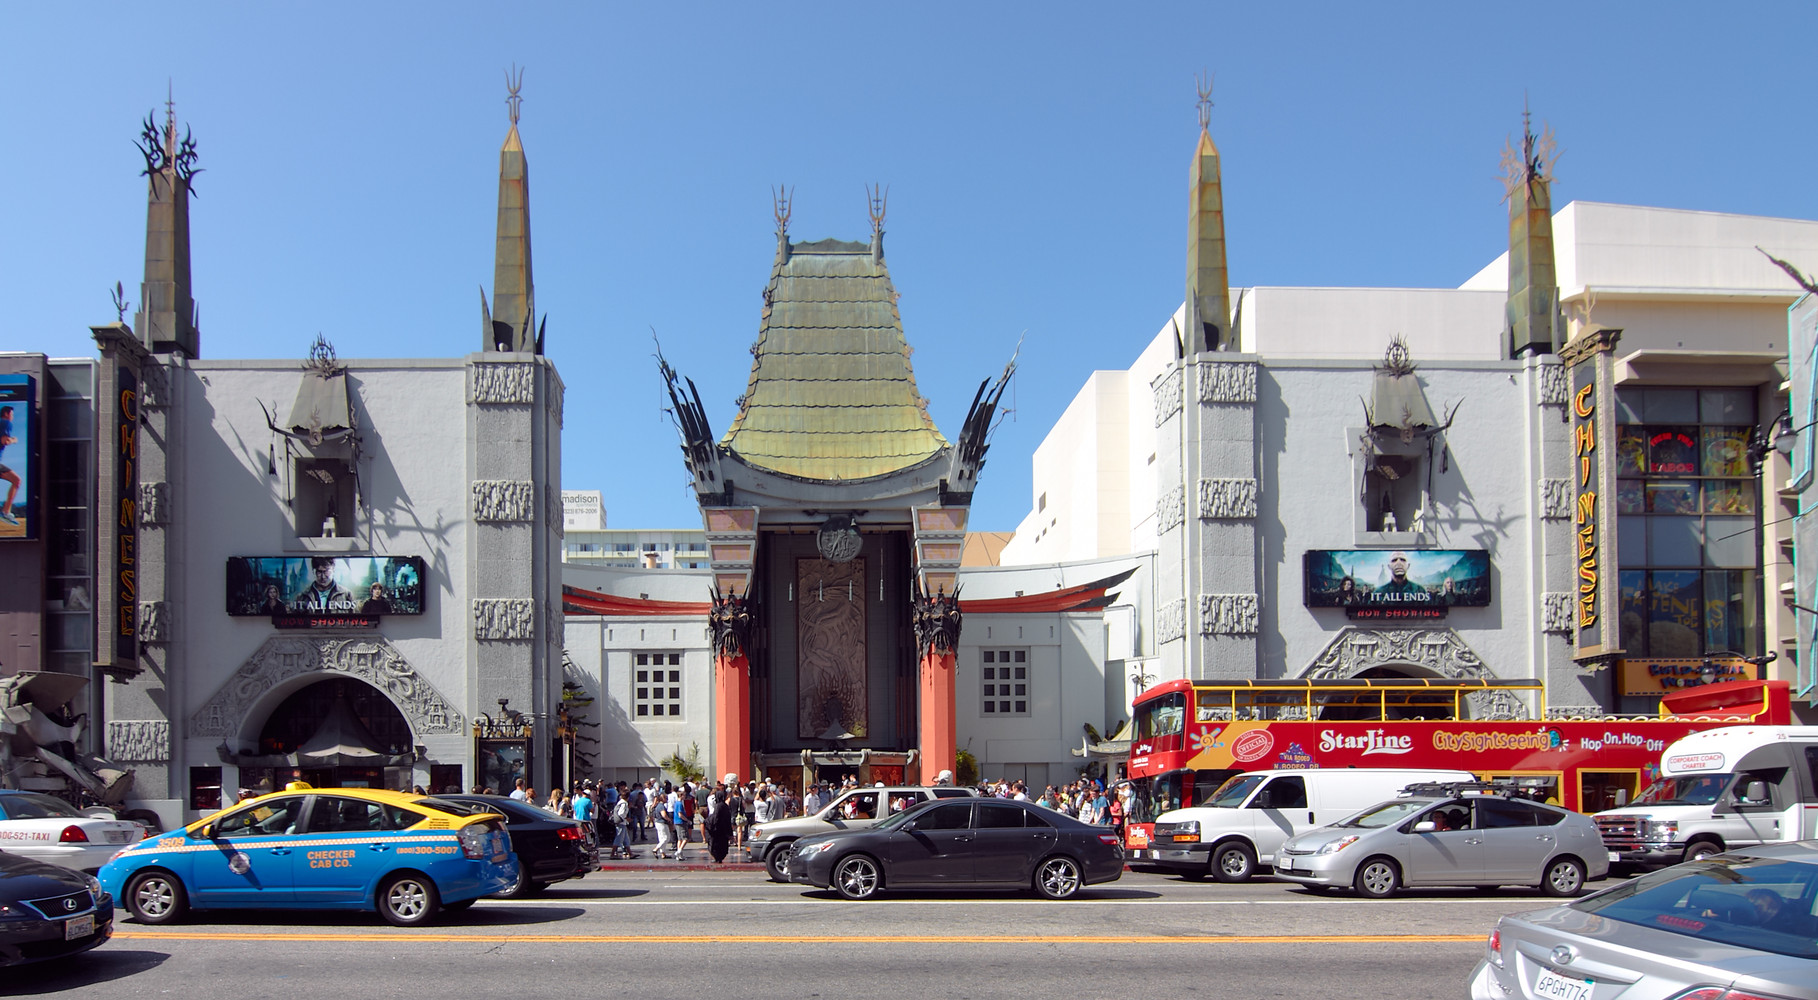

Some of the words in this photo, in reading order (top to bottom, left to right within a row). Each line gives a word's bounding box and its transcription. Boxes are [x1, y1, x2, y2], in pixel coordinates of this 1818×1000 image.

[562, 494, 598, 503] madison
[1574, 383, 1597, 628] CHINESE
[121, 389, 136, 636] CHINESE
[1370, 592, 1381, 602] IT
[1383, 593, 1401, 602] ALL
[1403, 592, 1431, 602] ENDS
[293, 600, 305, 610] IT
[306, 600, 326, 610] ALL
[328, 600, 357, 610] ENDS
[1319, 728, 1414, 756] StarLine
[1432, 730, 1550, 753] CitySightseeing
[1669, 756, 1699, 764] CORPORATE
[1700, 754, 1722, 762] COACH
[157, 837, 185, 848] 3509
[307, 850, 355, 860] CHECKER
[310, 859, 332, 869] CAB
[334, 859, 352, 868] CO.
[1538, 976, 1588, 1000] 6PGH776
